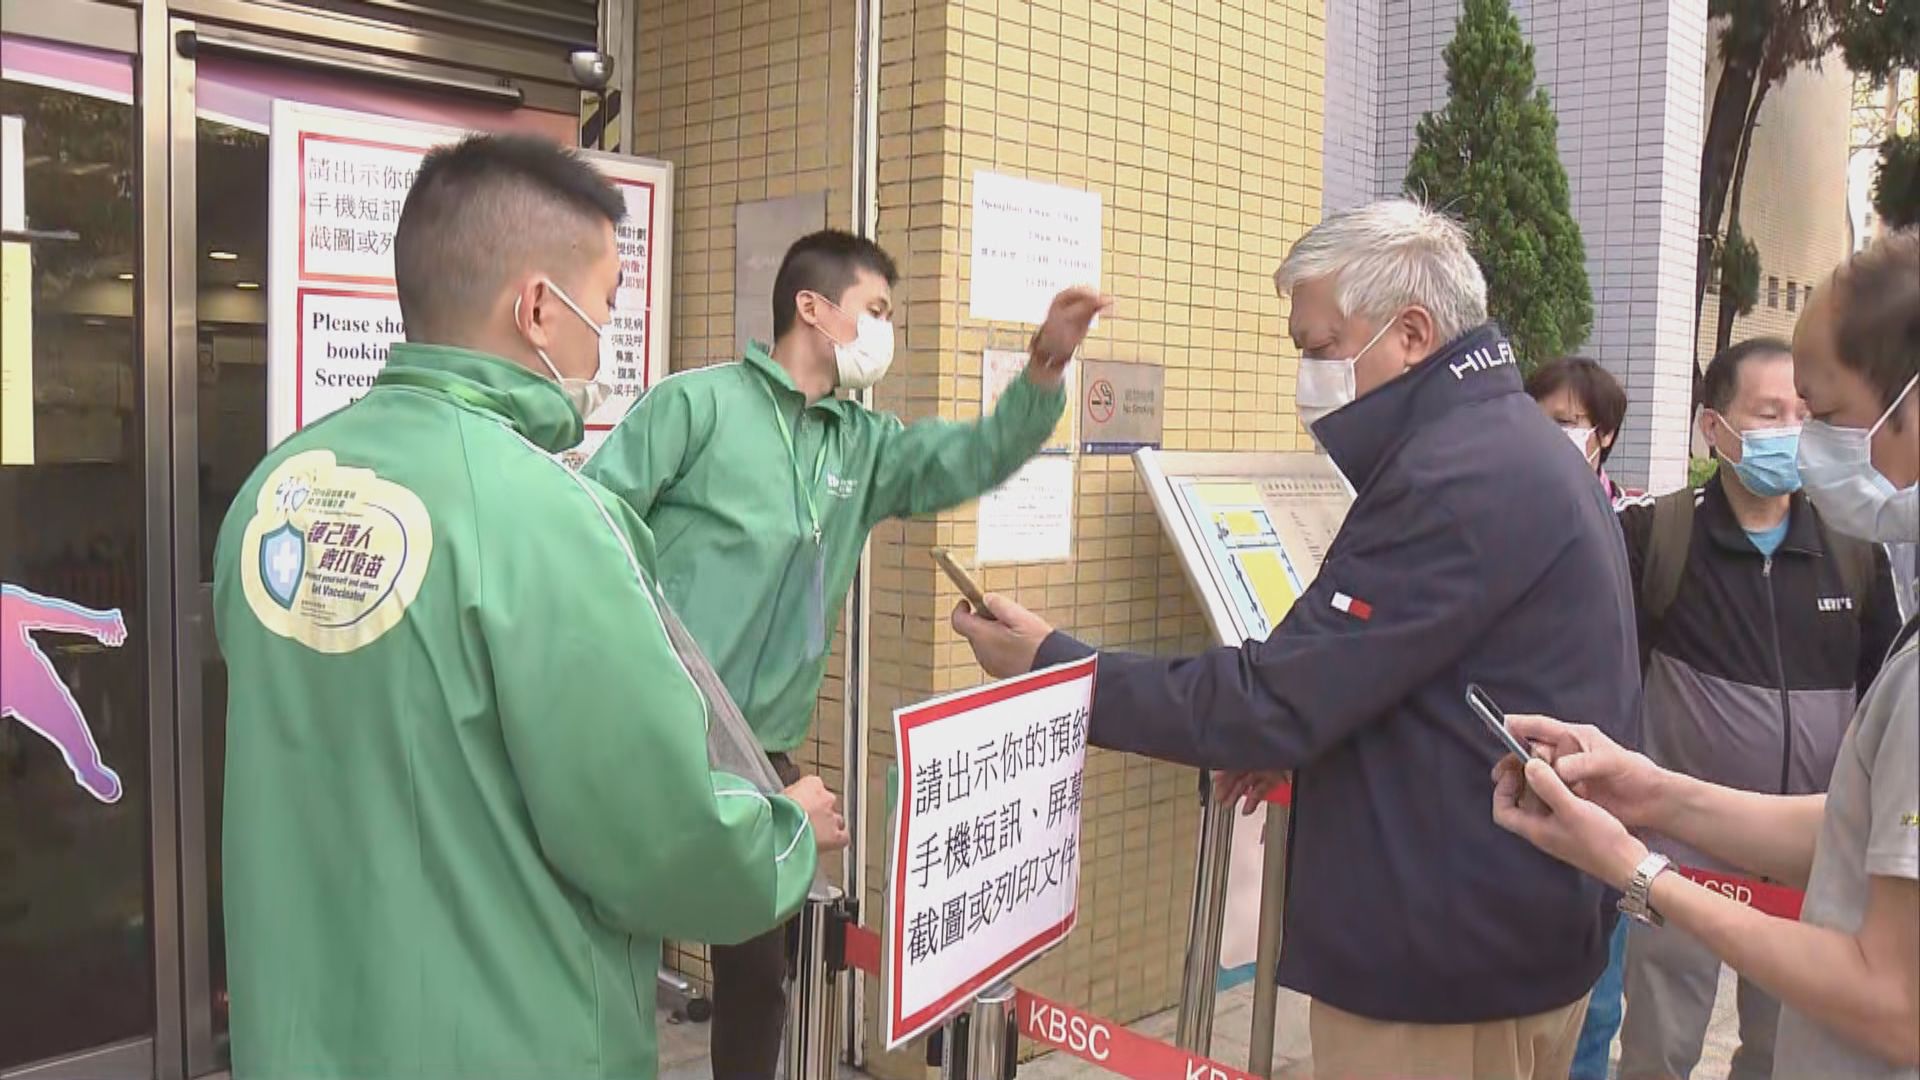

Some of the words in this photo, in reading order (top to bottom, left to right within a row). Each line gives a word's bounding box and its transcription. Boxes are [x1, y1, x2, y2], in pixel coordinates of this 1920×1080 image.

[309, 192, 401, 223] 手機短訊
[313, 312, 370, 333] Please
[327, 342, 388, 360] bookin
[307, 520, 374, 550] 護己護人
[318, 548, 386, 579] 齊打疫苗
[915, 707, 1088, 818] 請出示你的預約
[910, 771, 1083, 889] 手機短訊、屏幕
[907, 833, 1077, 967] 截圖或列印文件
[1691, 875, 1752, 905] SD
[1028, 999, 1111, 1062] KBSC
